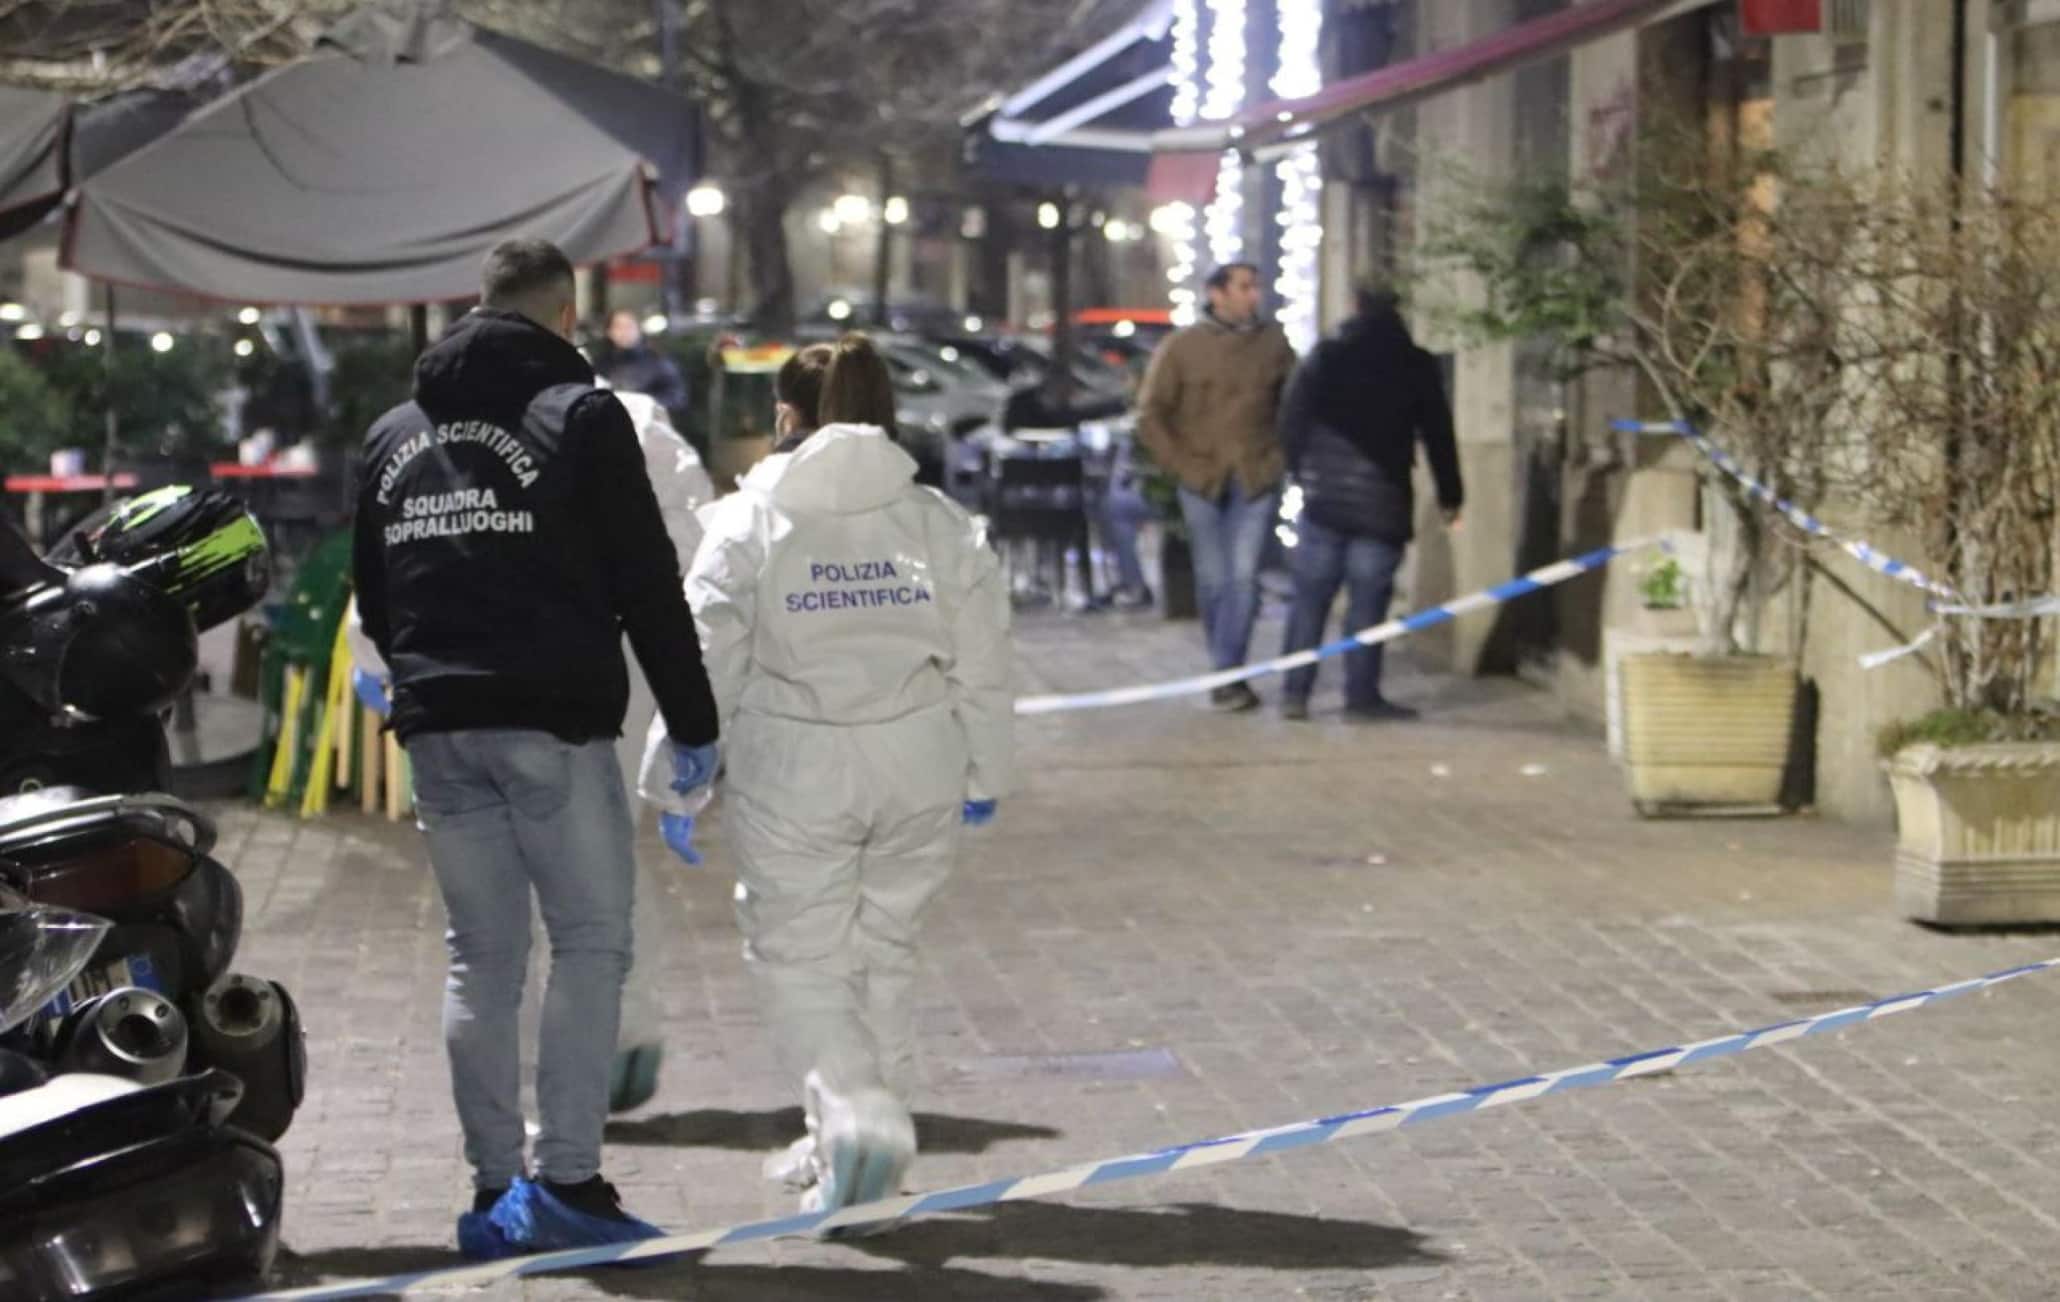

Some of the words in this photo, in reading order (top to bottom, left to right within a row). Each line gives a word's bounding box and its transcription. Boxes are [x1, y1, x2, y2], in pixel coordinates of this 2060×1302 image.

[376, 431, 432, 505] POLIZIA
[436, 420, 540, 488] SCIENTIFICA
[403, 488, 497, 519] SQUADRA
[384, 511, 533, 547] SOPRALLUOGHI
[811, 561, 897, 583] POLIZIA
[785, 586, 931, 612] SCIENTIFICA
